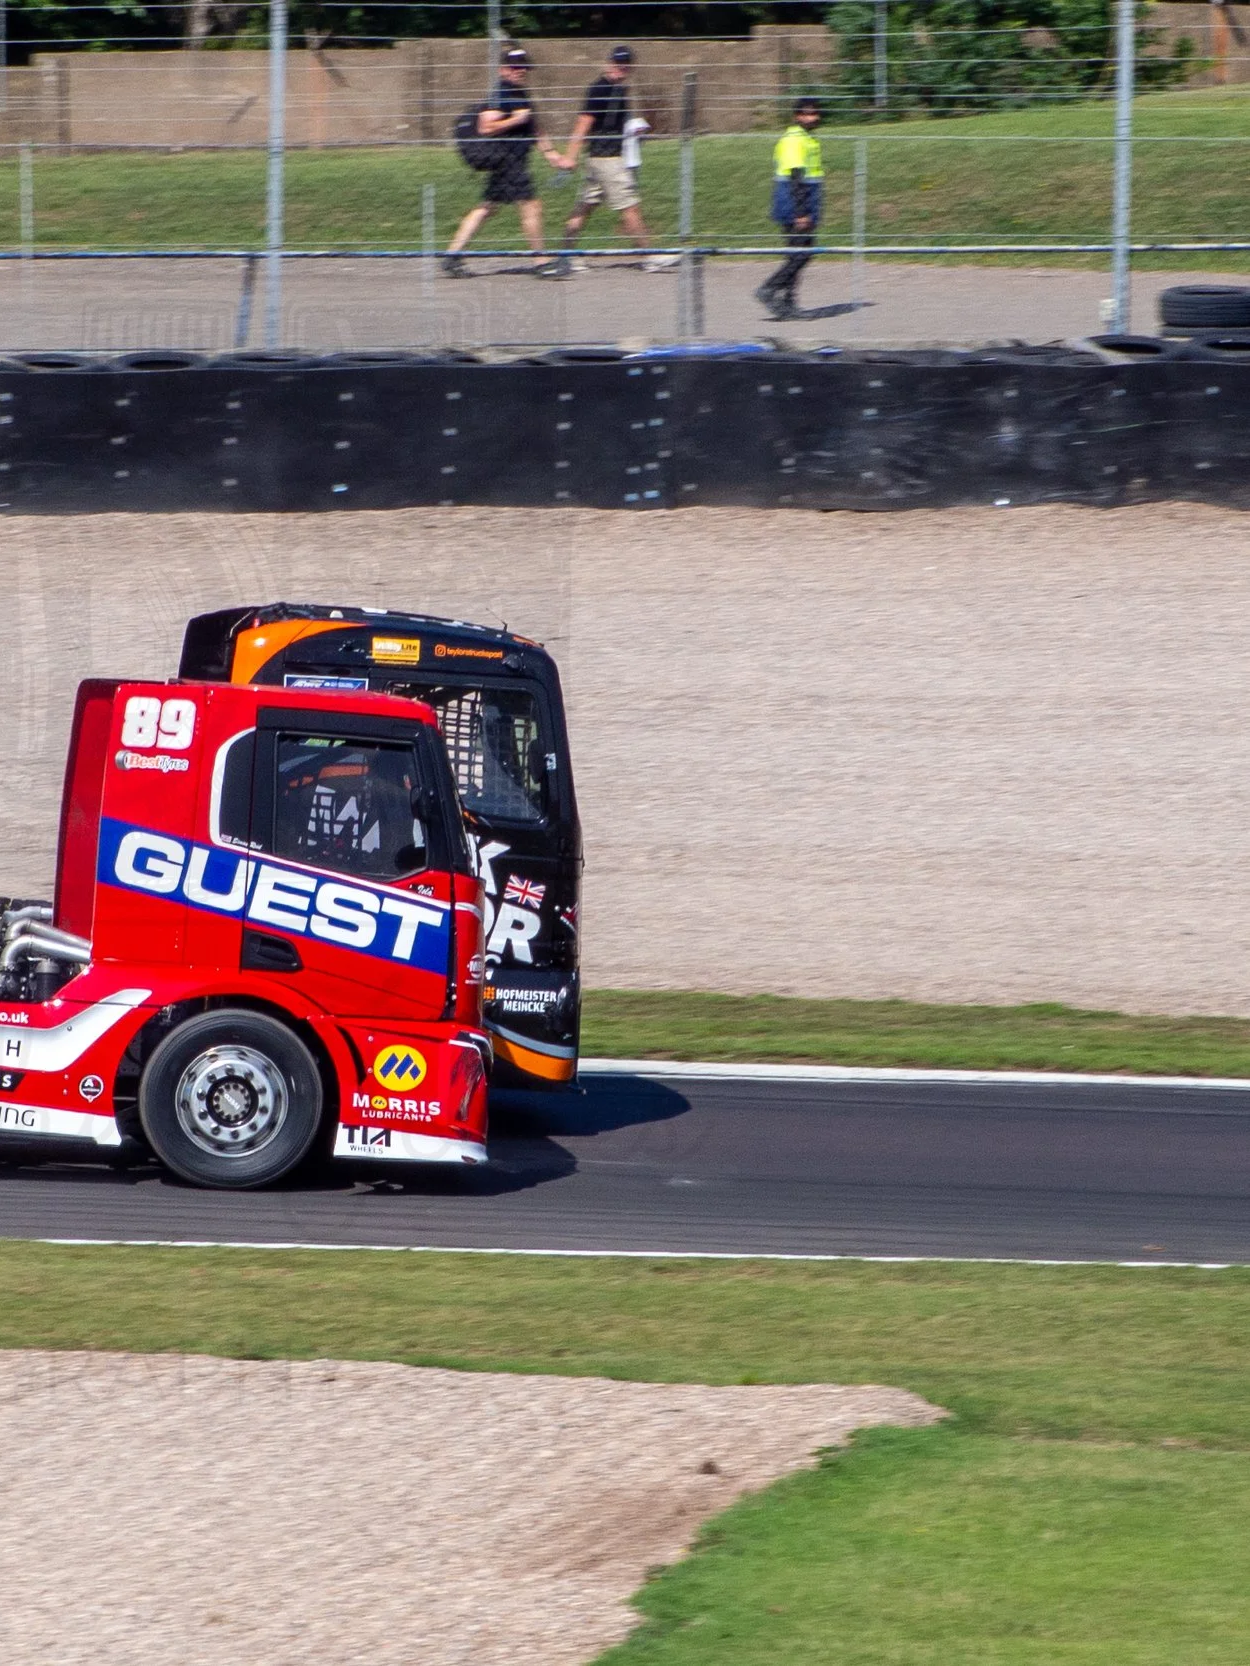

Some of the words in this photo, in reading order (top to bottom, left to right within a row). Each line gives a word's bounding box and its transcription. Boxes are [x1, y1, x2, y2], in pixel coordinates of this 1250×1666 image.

[121, 696, 197, 750] 89
[114, 831, 443, 960] GUEST
[496, 988, 557, 1002] HOFMEISTER
[503, 1001, 545, 1012] MEINCKE
[353, 1093, 441, 1115] MORRIS
[362, 1109, 432, 1122] LUBRICANTS
[350, 1145, 383, 1154] WHEELS
